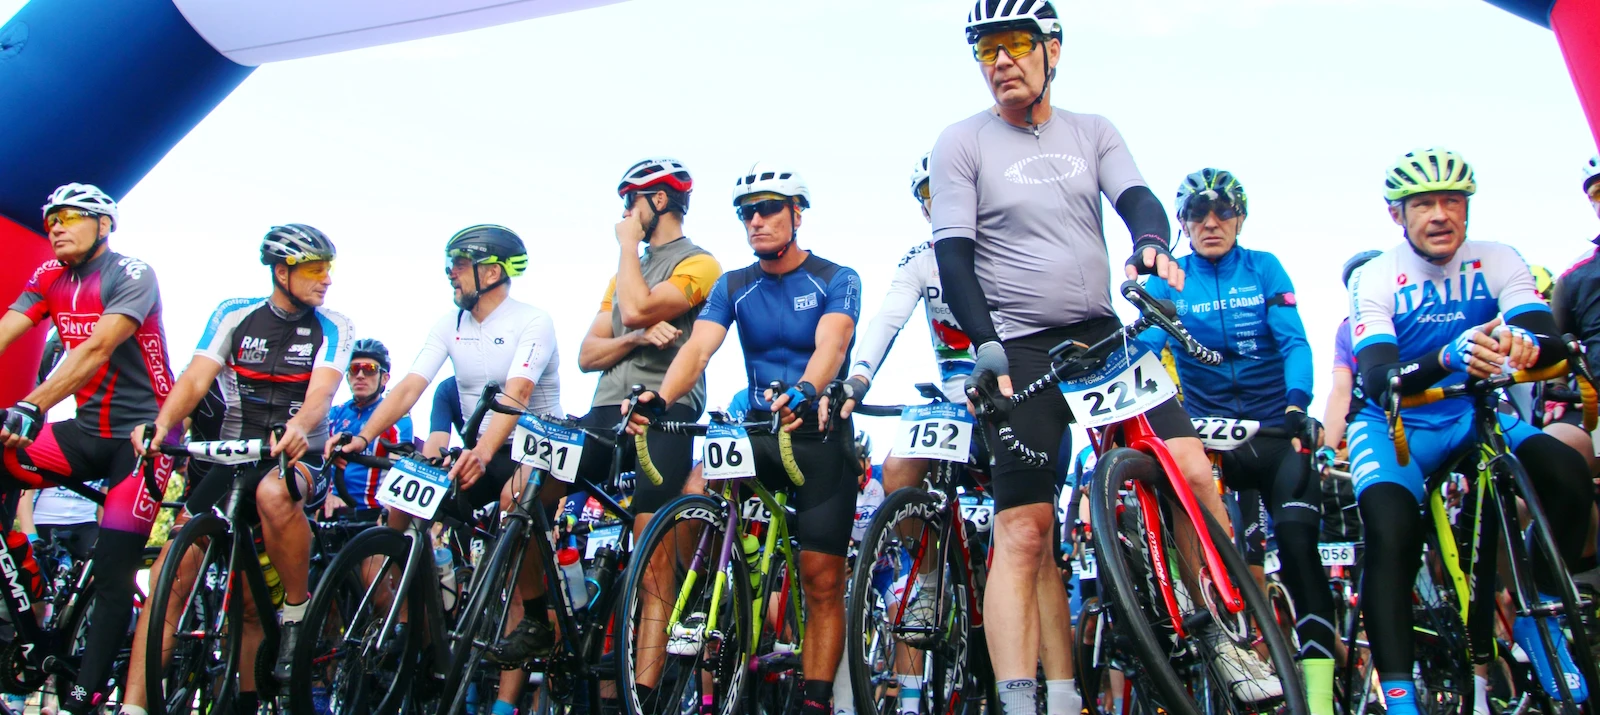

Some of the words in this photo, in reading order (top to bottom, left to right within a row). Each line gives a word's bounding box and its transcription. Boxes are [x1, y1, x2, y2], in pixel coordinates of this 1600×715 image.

[1192, 302, 1211, 313] WTC
[1213, 299, 1228, 311] DE
[1229, 293, 1266, 309] CADANS
[1394, 271, 1497, 315] ITALIA
[241, 335, 270, 352] RAIL
[1082, 365, 1159, 418] 224
[909, 422, 959, 451] 152
[1193, 418, 1248, 441] 226
[200, 439, 250, 457] 143
[523, 433, 569, 471] 021
[703, 441, 743, 469] 06
[388, 474, 436, 508] 400
[1321, 548, 1349, 561] 056
